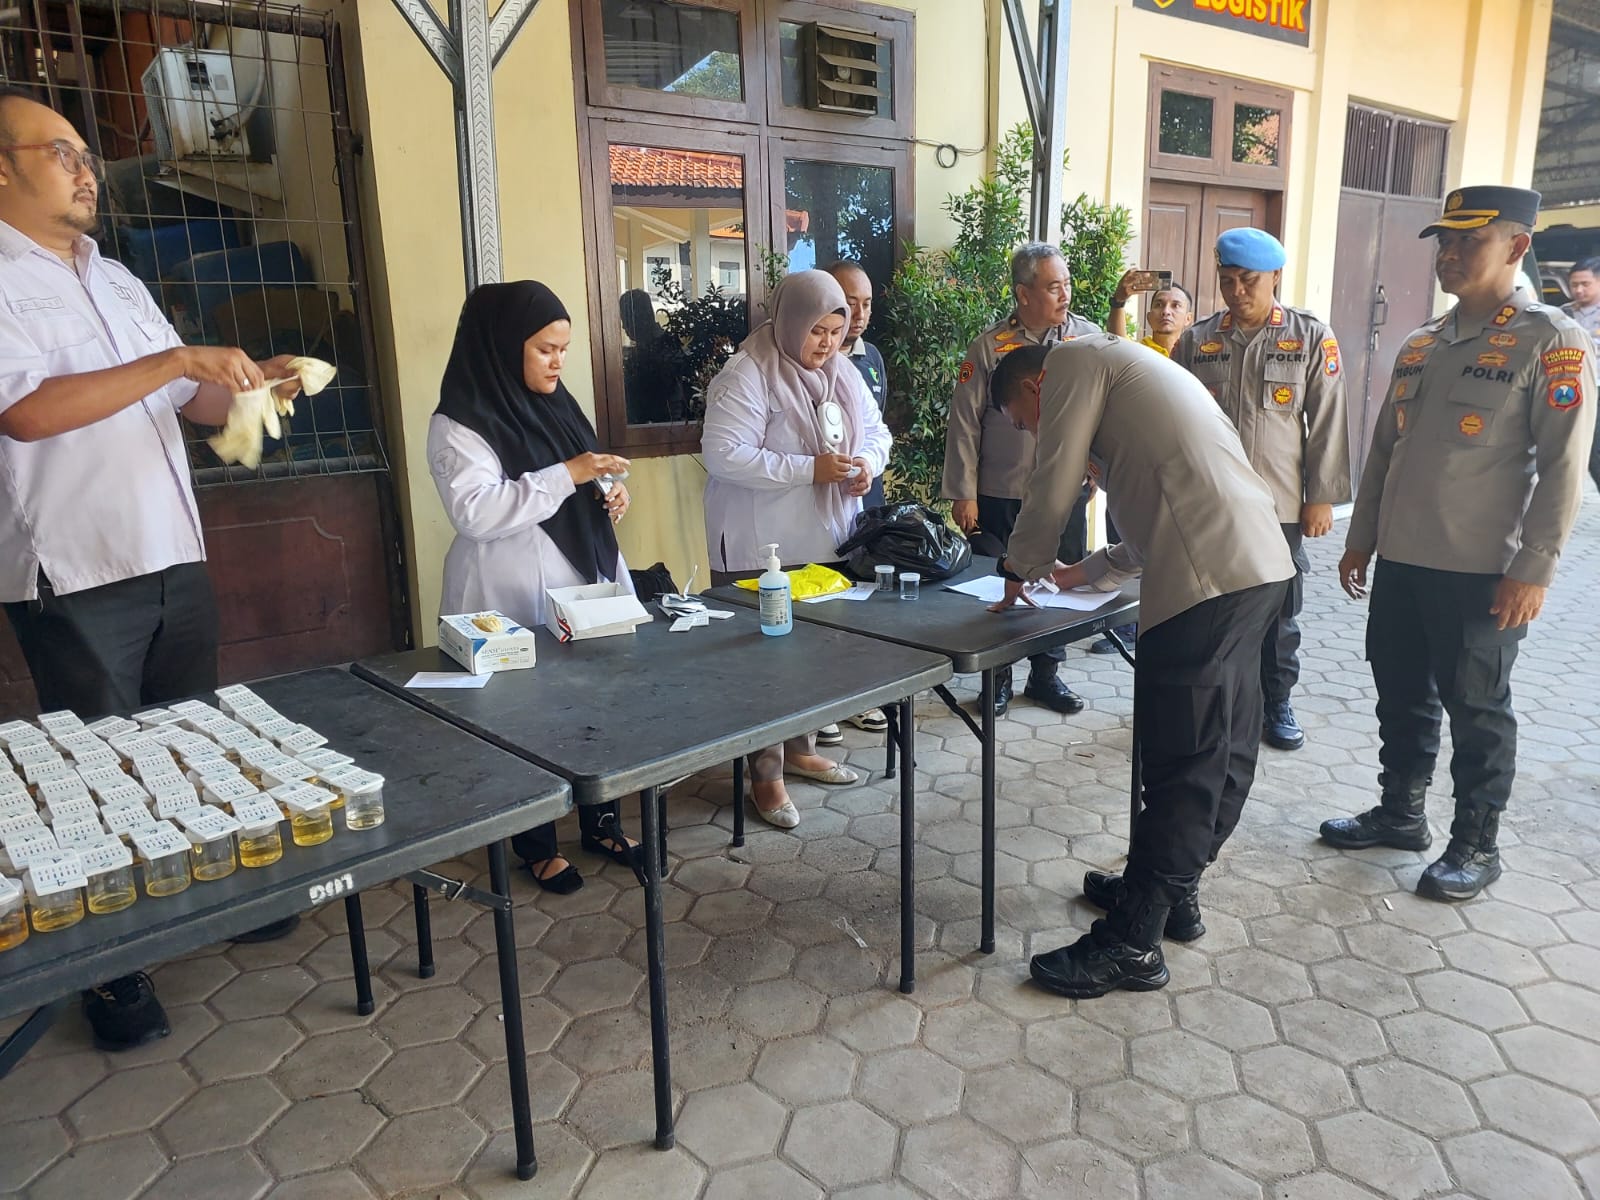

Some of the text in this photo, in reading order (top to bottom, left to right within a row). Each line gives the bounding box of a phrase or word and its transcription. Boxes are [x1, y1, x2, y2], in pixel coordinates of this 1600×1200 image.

[1193, 0, 1306, 32] GISTIK
[1266, 353, 1306, 363] POLRI
[1461, 366, 1514, 384] POLRI
